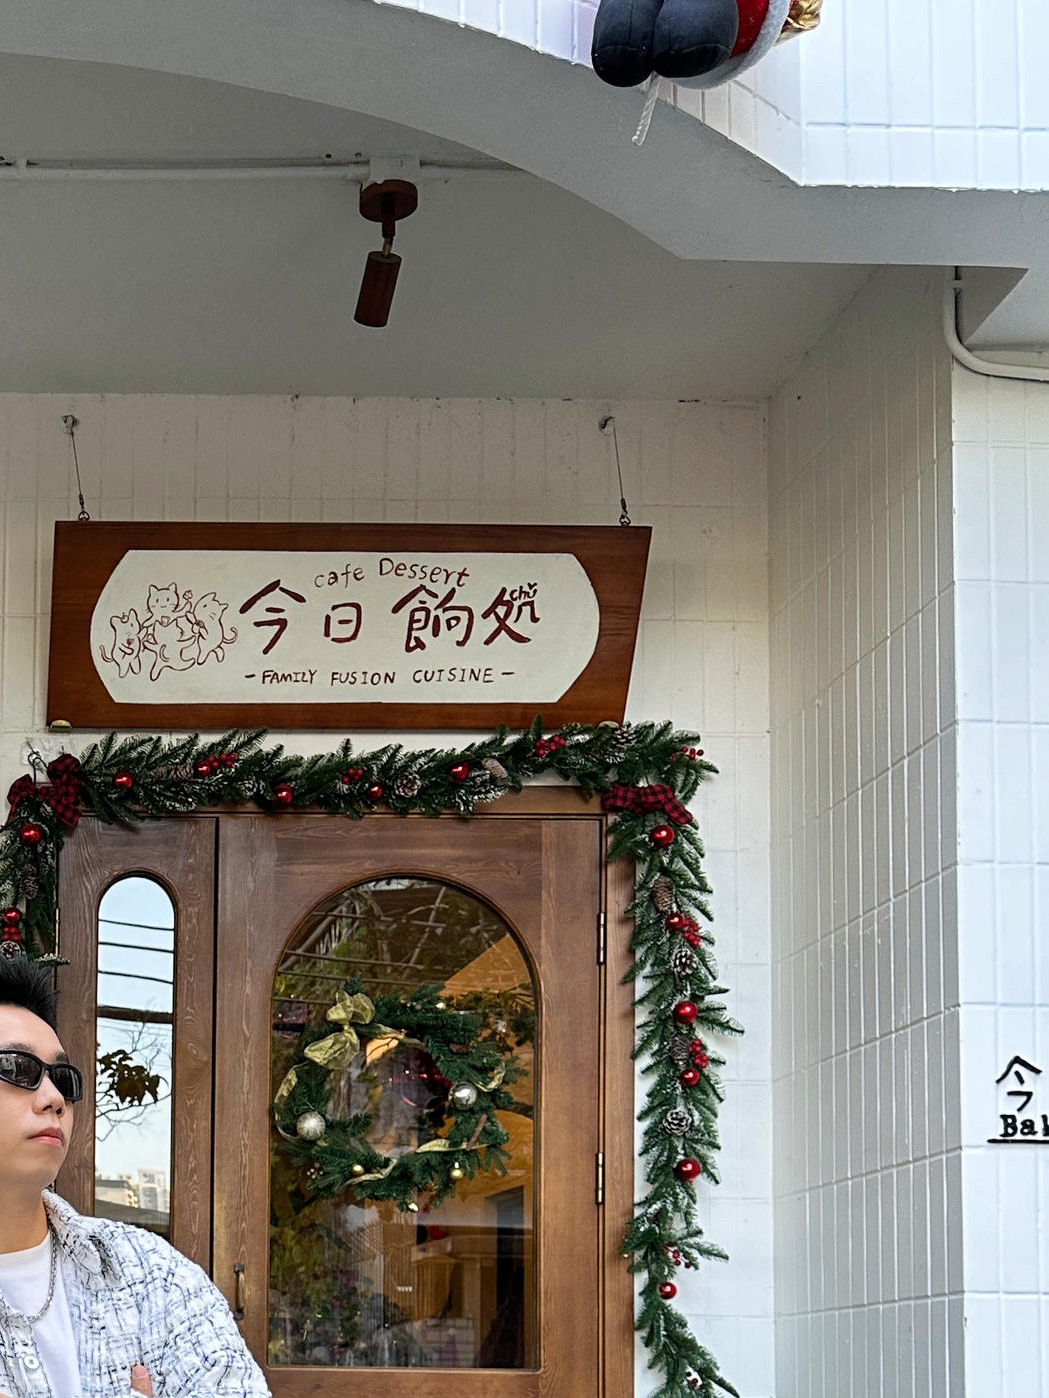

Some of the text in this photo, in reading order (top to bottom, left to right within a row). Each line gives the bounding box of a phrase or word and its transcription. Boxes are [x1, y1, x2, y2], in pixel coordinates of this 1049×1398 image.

[314, 557, 470, 589] cafe Dessert
[331, 671, 396, 686] FUSION
[995, 1055, 1043, 1113] 今
